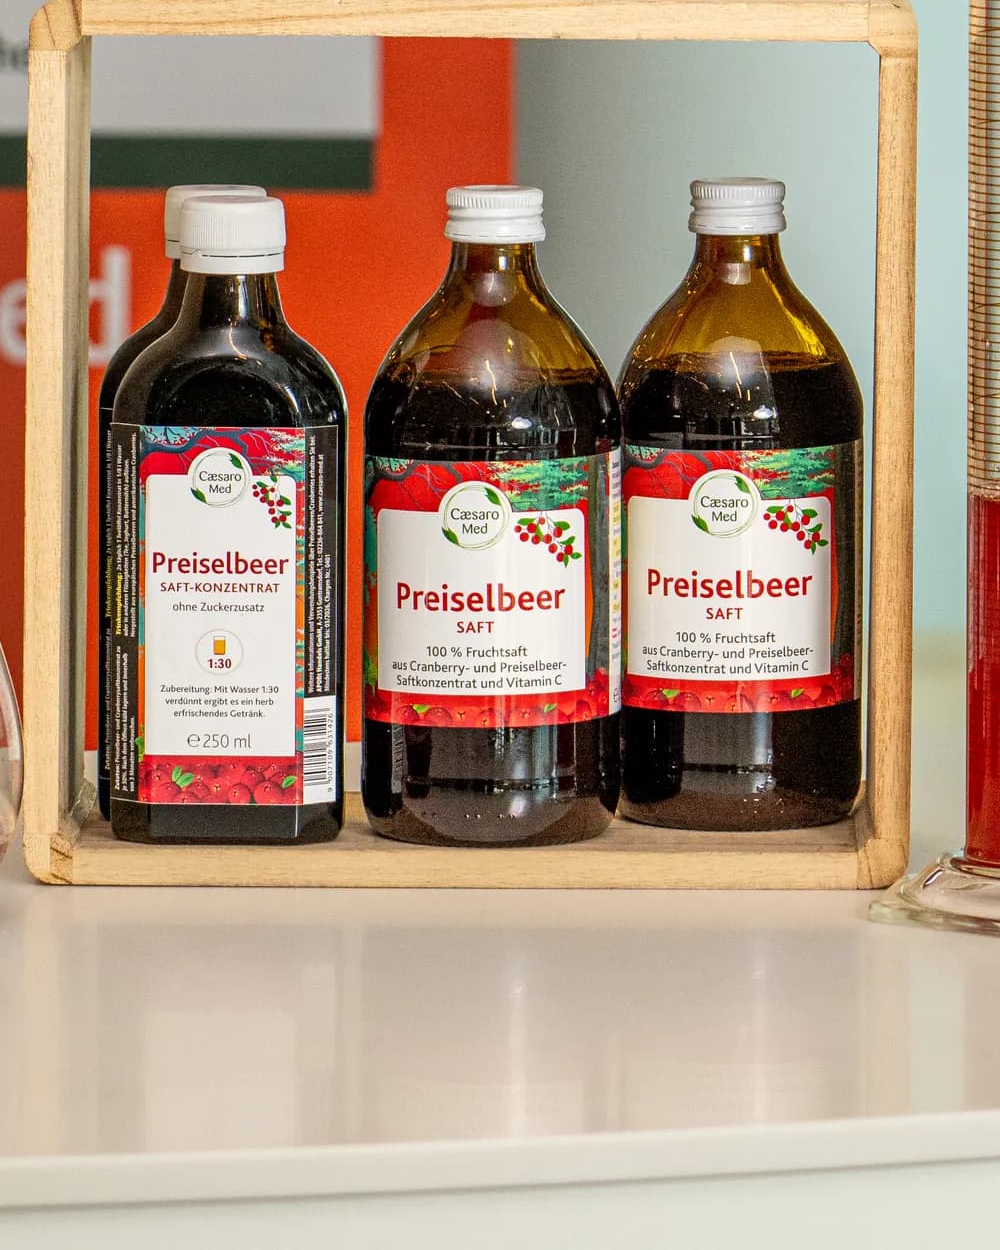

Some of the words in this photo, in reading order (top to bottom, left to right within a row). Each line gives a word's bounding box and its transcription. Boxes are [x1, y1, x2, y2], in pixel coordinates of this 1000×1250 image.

[199, 470, 242, 482] Cæsaro
[208, 483, 232, 494] Med
[700, 495, 749, 509] Cæsaro
[450, 507, 500, 521] Cæsaro
[711, 511, 738, 523] Med
[461, 523, 488, 535] Med
[152, 551, 289, 575] Preiselbeer
[160, 582, 280, 593] SAFT-KONZENTRAT
[647, 568, 813, 599] Preiselbeer
[396, 582, 566, 613] Preiselbeer
[172, 602, 198, 612] ohne
[200, 602, 265, 612] Zuckerzusatz
[705, 607, 744, 620] SAFT
[456, 621, 495, 634] SAFT
[675, 631, 697, 643] 100
[699, 632, 712, 644] %
[715, 632, 776, 644] Fruchtsaft
[426, 646, 448, 658] 100
[450, 646, 463, 658] %
[466, 646, 528, 658] Fruchtsaft
[642, 646, 658, 656] aus
[659, 646, 719, 661] Cranberry-
[722, 647, 745, 659] und
[748, 645, 814, 659] Preiselbeer-
[207, 658, 232, 669] 1:30
[392, 661, 408, 671] aus
[409, 660, 470, 677] Cranberry-
[473, 661, 497, 674] und
[499, 659, 567, 673] Preiselbeer-
[646, 660, 726, 675] Saftkonzentrat
[729, 662, 752, 675] und
[754, 661, 799, 674] Vitamin
[801, 660, 809, 671] C
[396, 674, 478, 689] Saftkonzentrat
[480, 677, 504, 689] und
[506, 675, 553, 689] Vitamin
[554, 674, 563, 686] C
[160, 685, 212, 696] Zubereitung:
[214, 685, 228, 693] Mit
[229, 685, 259, 694] Wasser
[262, 685, 279, 694] 1:30
[165, 697, 202, 706] verdünnt
[203, 697, 228, 708] ergibt
[241, 698, 254, 706] ein
[255, 697, 274, 706] herb
[173, 709, 228, 718] erfrischendes
[229, 709, 266, 718] Getränk.
[202, 733, 230, 749] 250
[233, 733, 252, 749] ml
